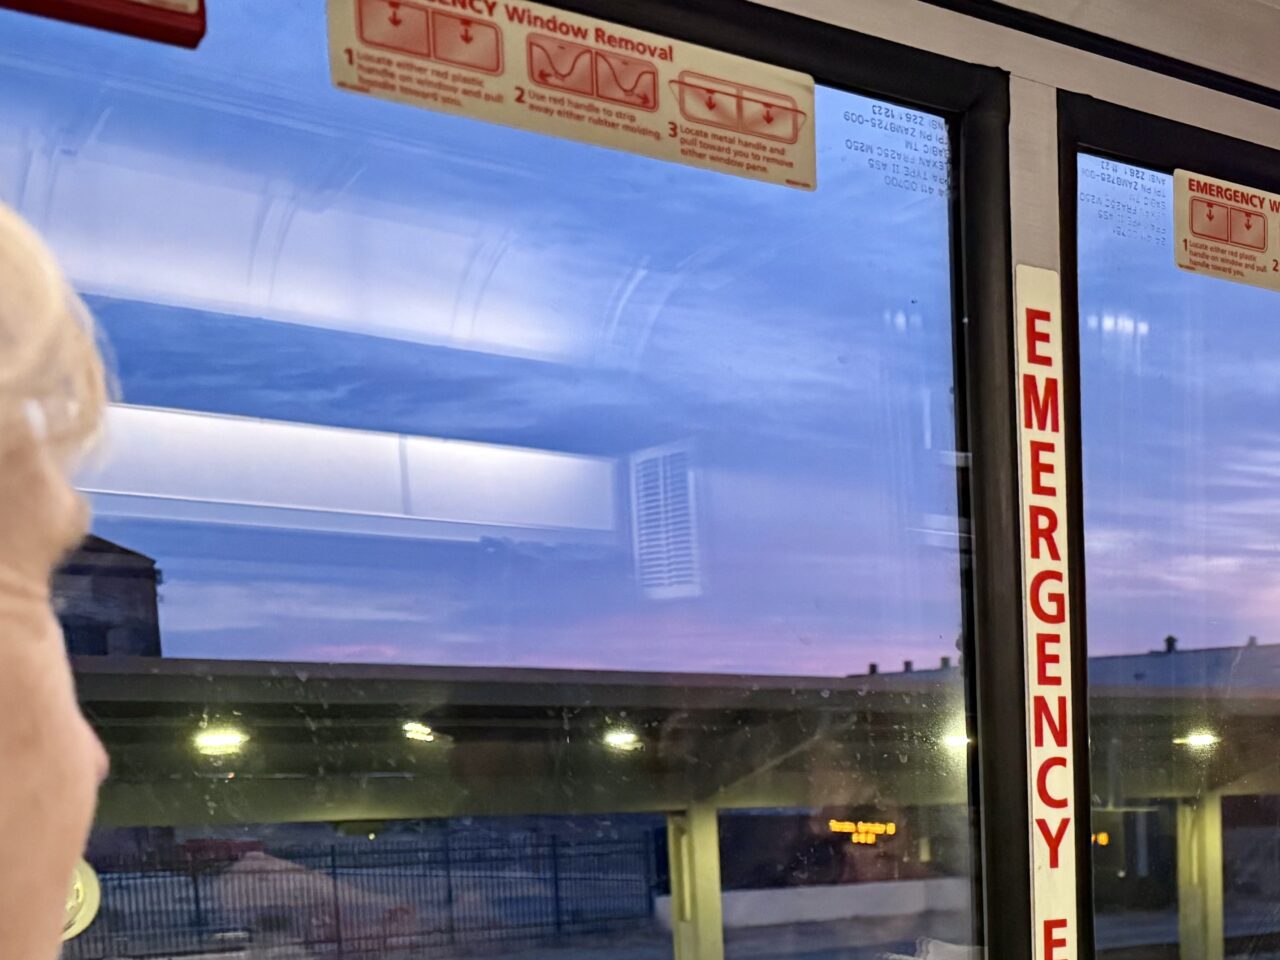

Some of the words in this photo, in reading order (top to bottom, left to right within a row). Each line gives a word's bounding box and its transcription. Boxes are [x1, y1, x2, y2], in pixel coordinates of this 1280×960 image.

[504, 4, 588, 40] Window
[594, 28, 674, 62] Removal
[345, 48, 354, 66] 1
[431, 68, 449, 80] red
[514, 86, 526, 104] 2
[528, 89, 546, 102] Use
[548, 93, 565, 106] red
[567, 97, 600, 115] handle
[602, 107, 613, 118] to
[615, 110, 637, 123] strip
[529, 103, 555, 117] away
[556, 107, 587, 123] either
[588, 114, 621, 130] rubber
[667, 121, 678, 138] 3
[680, 125, 709, 139] Locate
[711, 132, 736, 145] metal
[738, 136, 767, 151] handle
[769, 144, 786, 156] and
[680, 136, 698, 148] pull
[699, 140, 731, 154] toward
[733, 148, 750, 159] you
[751, 151, 761, 161] to
[763, 155, 794, 168] remove
[680, 148, 707, 160] either
[709, 153, 744, 169] window
[1188, 178, 1265, 209] EMERGENCY
[1183, 238, 1188, 252] 1
[1272, 259, 1279, 272] 2
[1023, 307, 1070, 868] EMERGENCY
